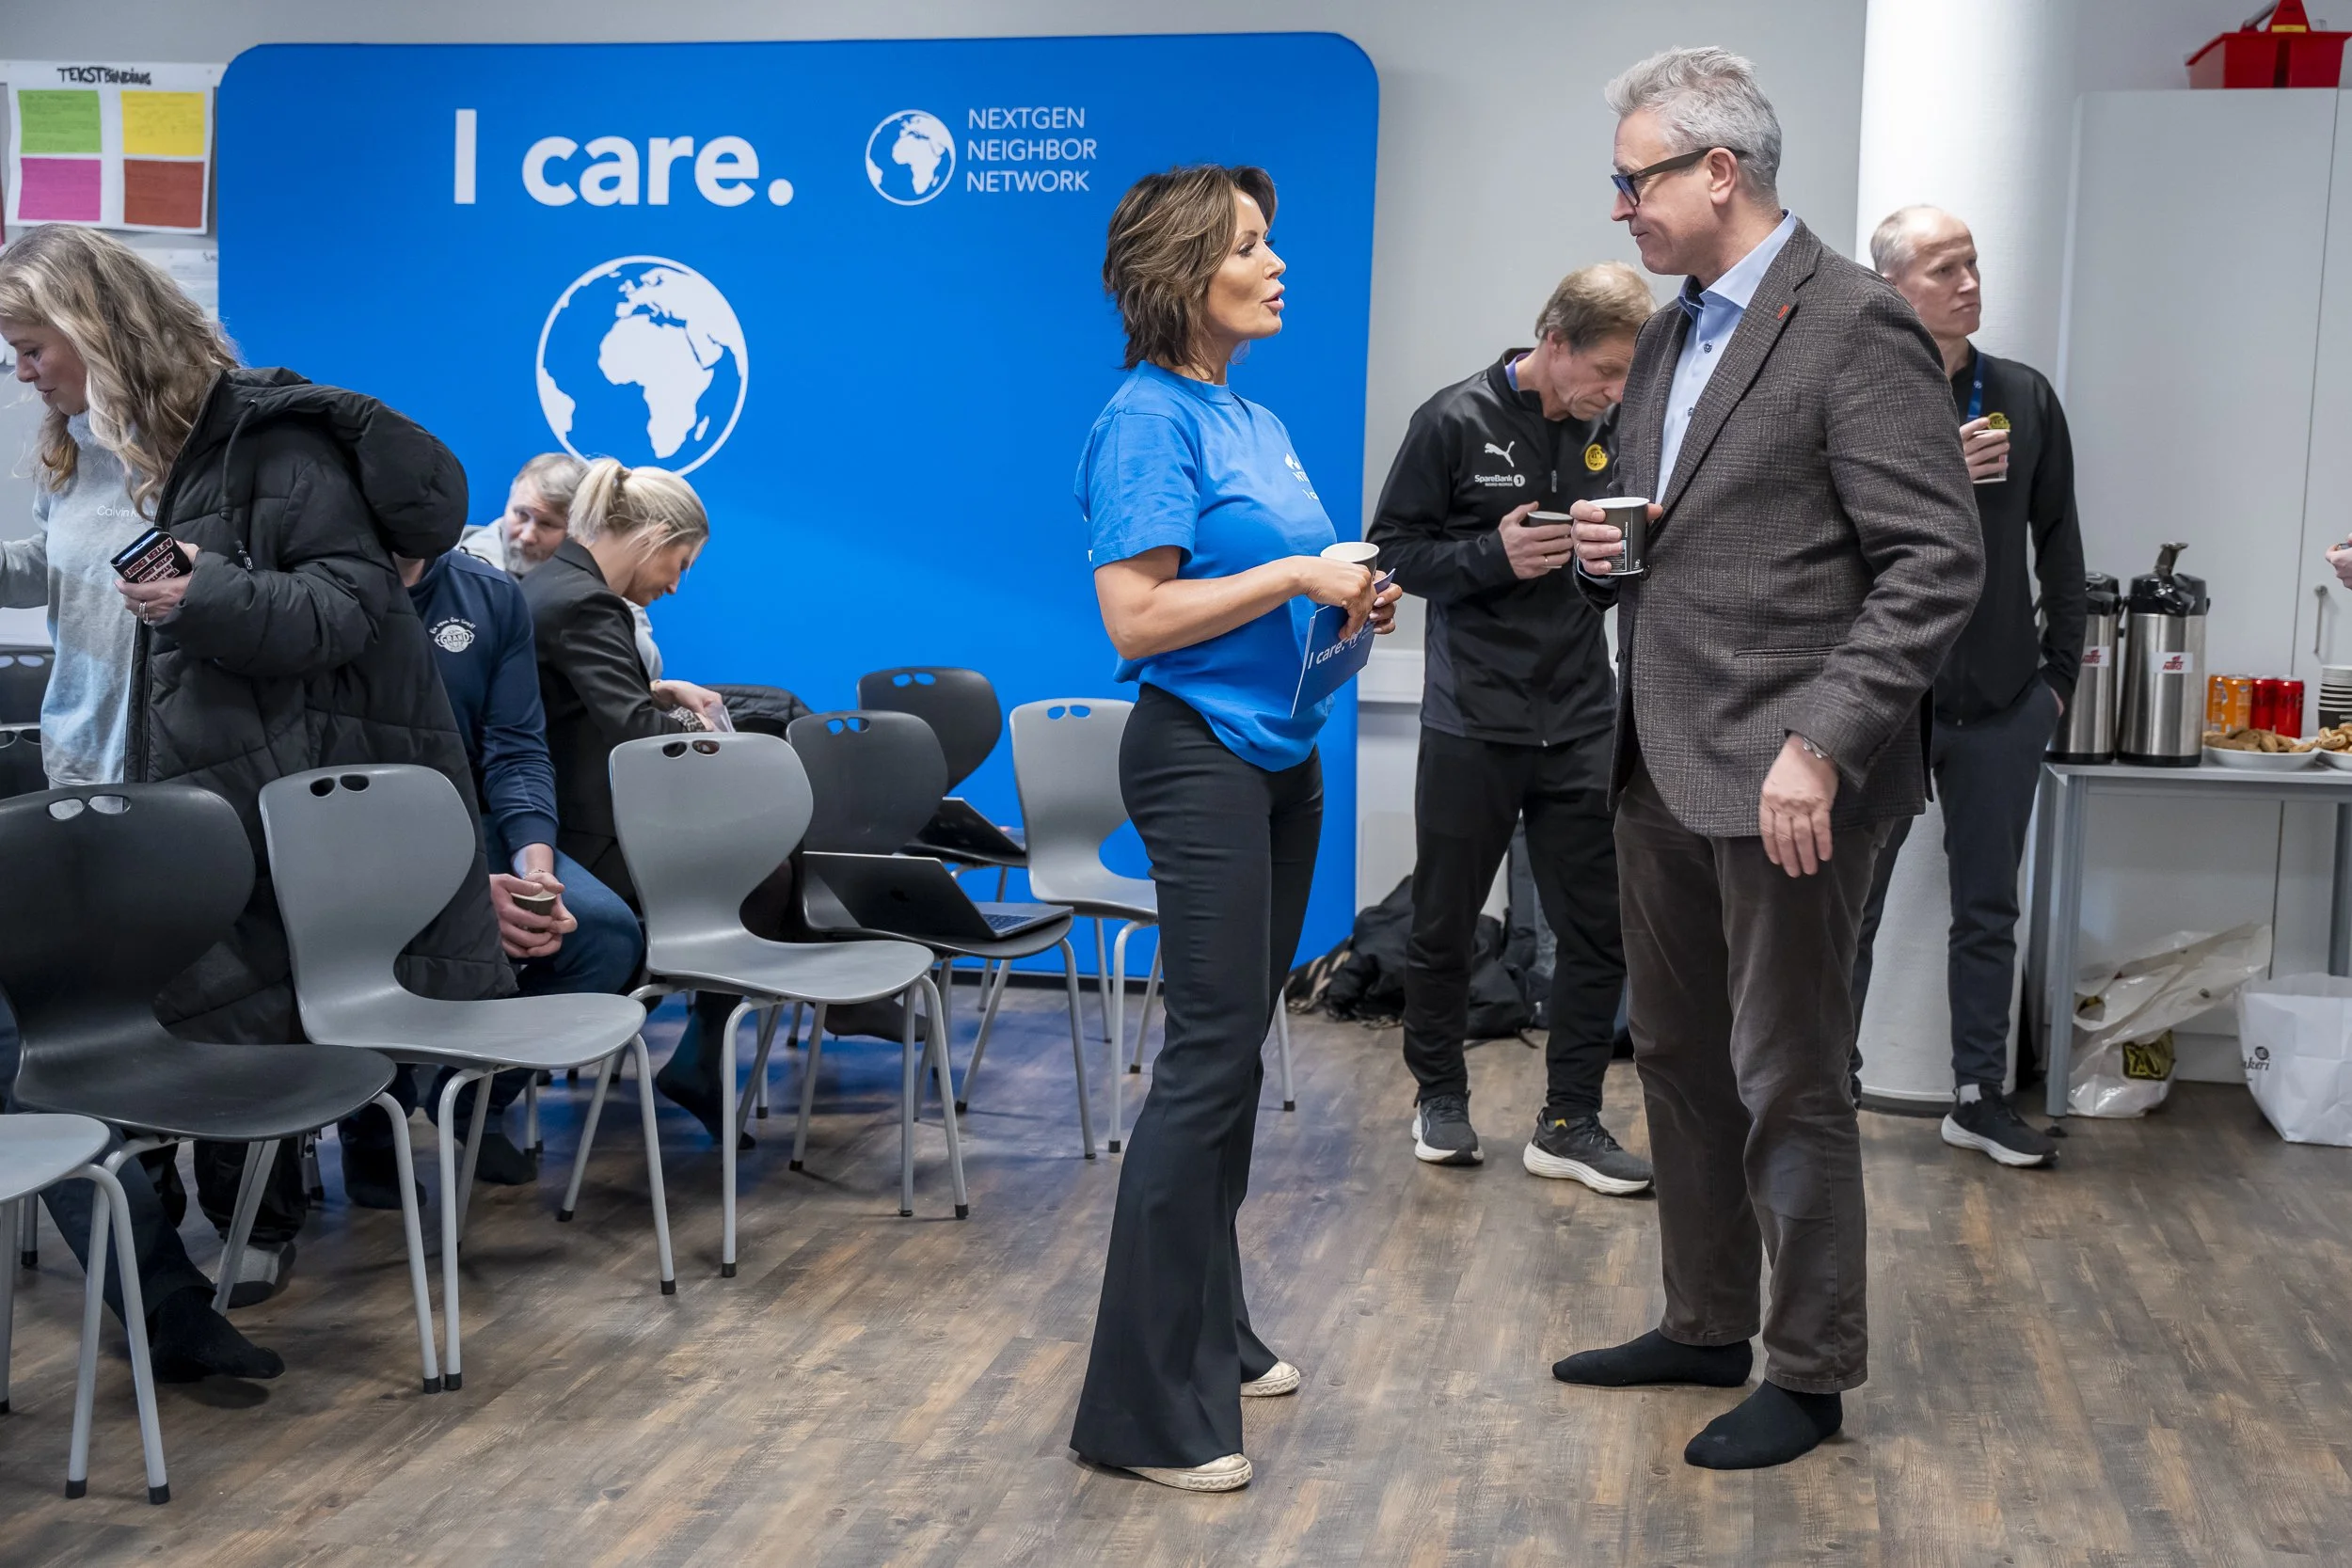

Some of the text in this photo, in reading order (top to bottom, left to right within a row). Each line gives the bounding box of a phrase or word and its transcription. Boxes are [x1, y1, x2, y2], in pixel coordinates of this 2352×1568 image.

[968, 107, 1085, 129] NEXTGEN
[455, 108, 794, 206] I care.
[967, 138, 1097, 161] NEIGHBOR
[966, 169, 1090, 193] NETWORK
[97, 505, 130, 517] Calvin
[1316, 641, 1344, 664] care.
